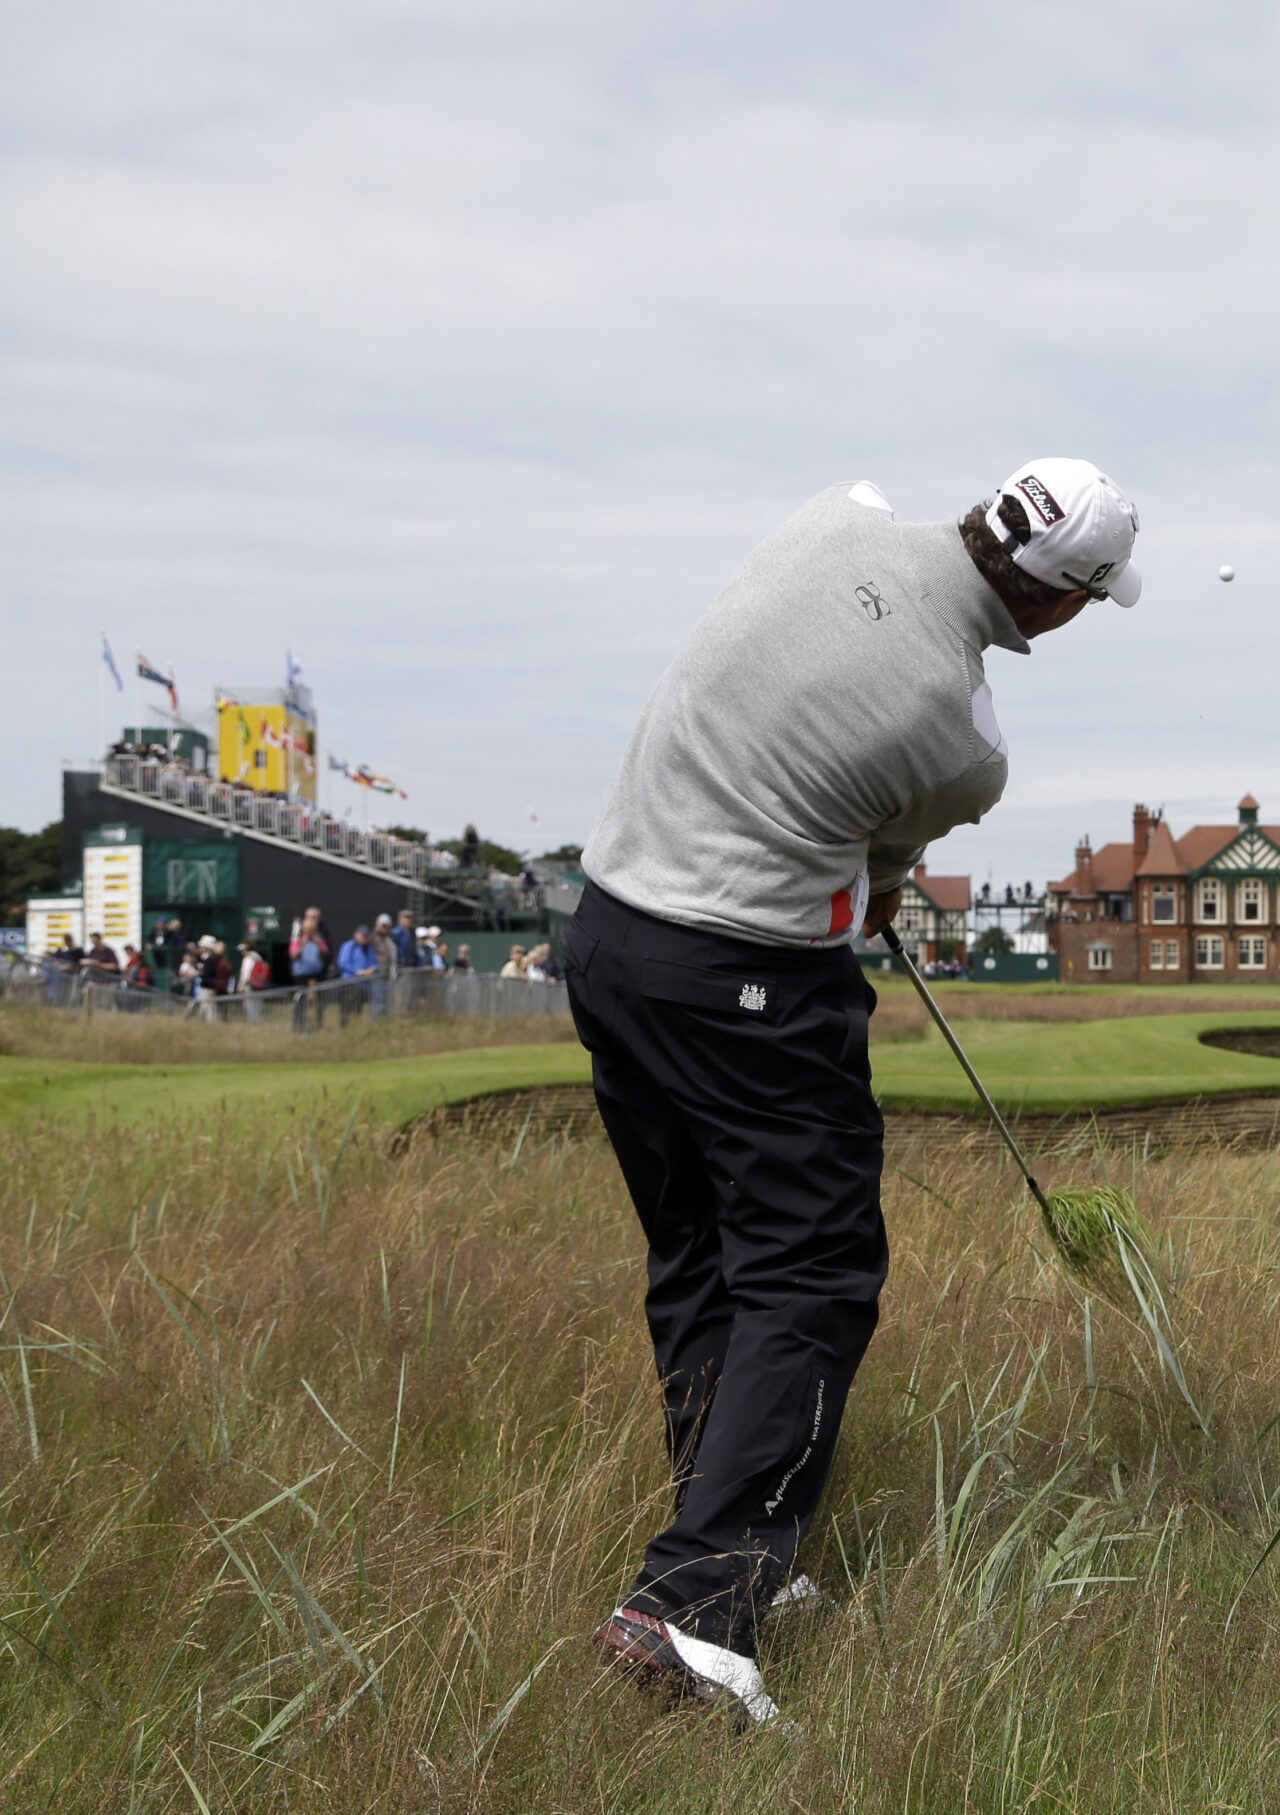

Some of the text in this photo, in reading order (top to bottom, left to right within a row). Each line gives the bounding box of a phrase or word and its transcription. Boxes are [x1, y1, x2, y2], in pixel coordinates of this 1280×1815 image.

[1017, 478, 1056, 521] Titleist
[764, 1379, 825, 1517] Aquascutum WATERSHIELD
